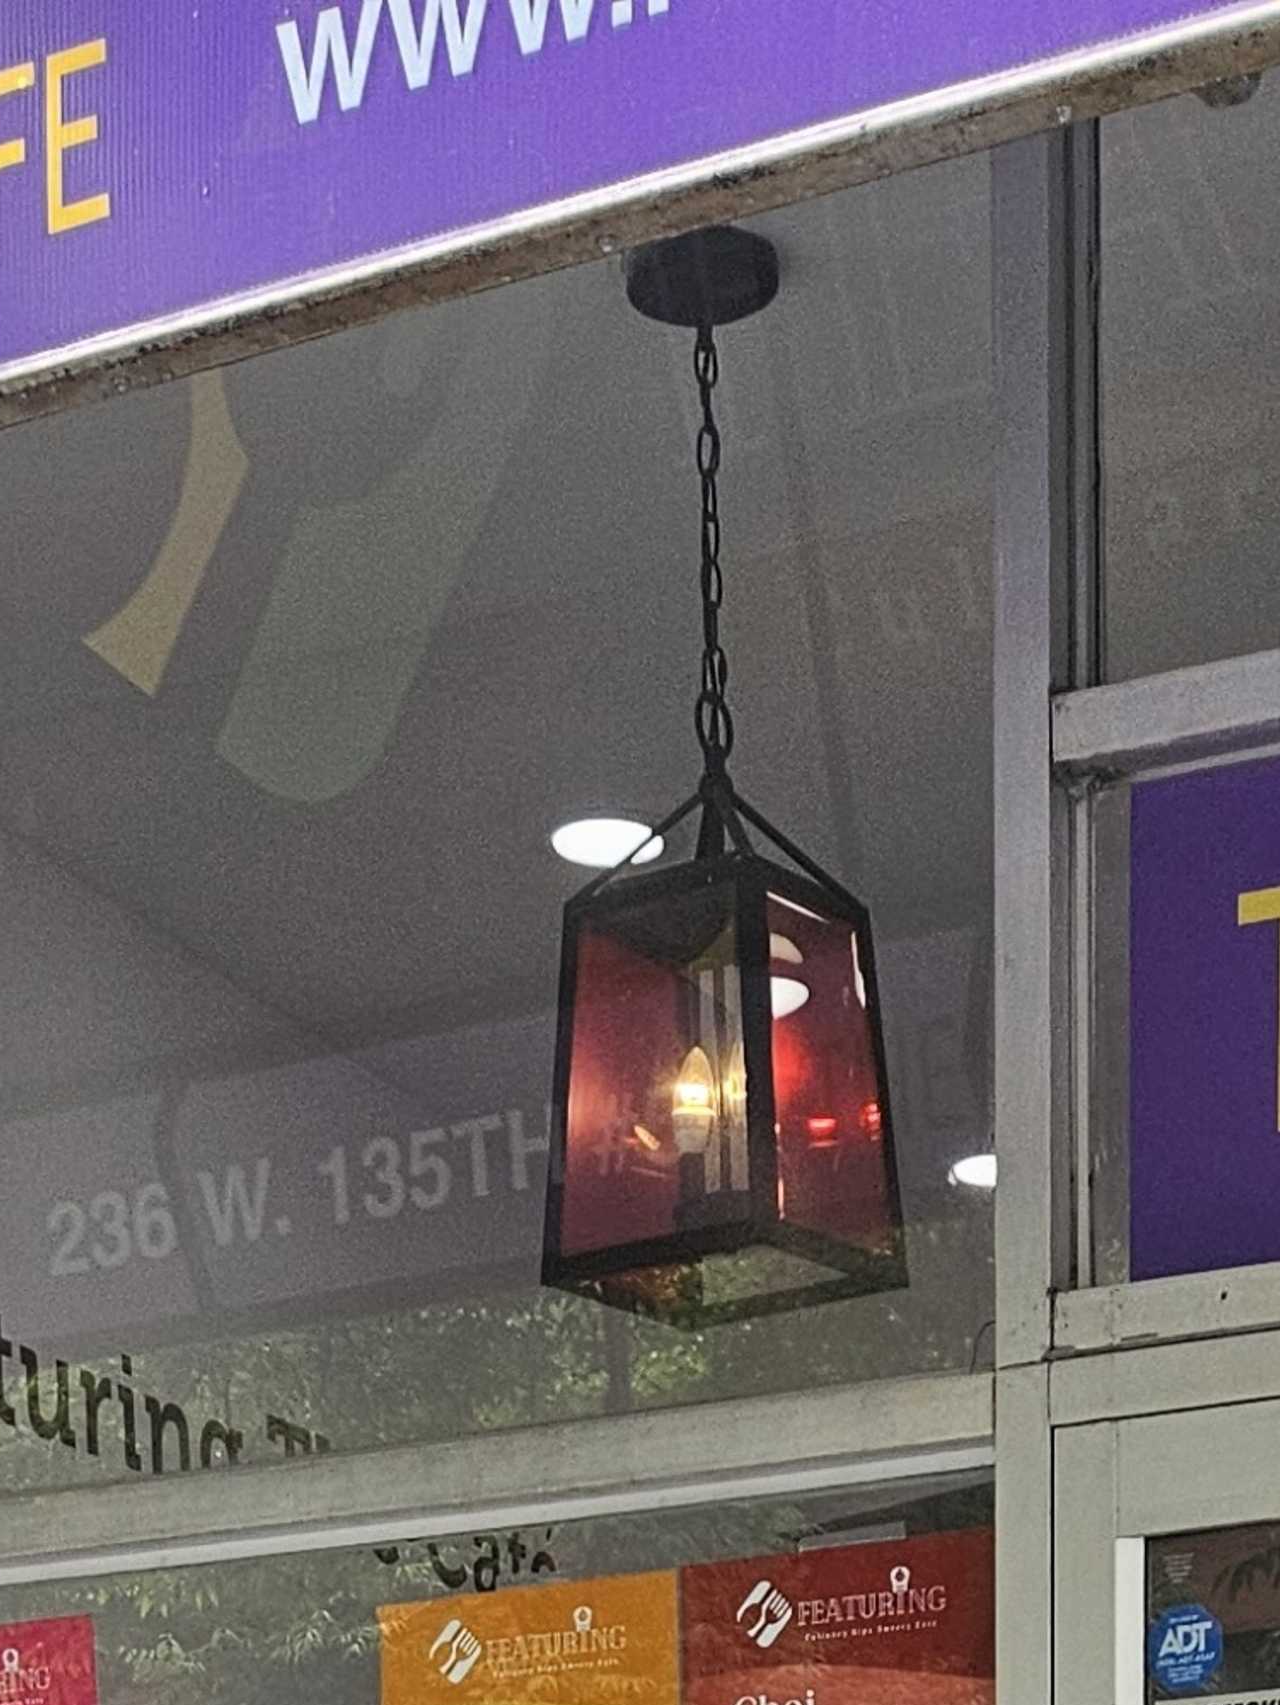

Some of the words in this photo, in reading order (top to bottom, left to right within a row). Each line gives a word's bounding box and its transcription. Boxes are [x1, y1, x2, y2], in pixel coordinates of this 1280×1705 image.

[46, 1182, 176, 1277] 236
[194, 1154, 291, 1252] W.
[798, 1584, 948, 1628] FEATURING
[486, 1624, 626, 1665] FEATURING
[1157, 1621, 1214, 1659] ADT
